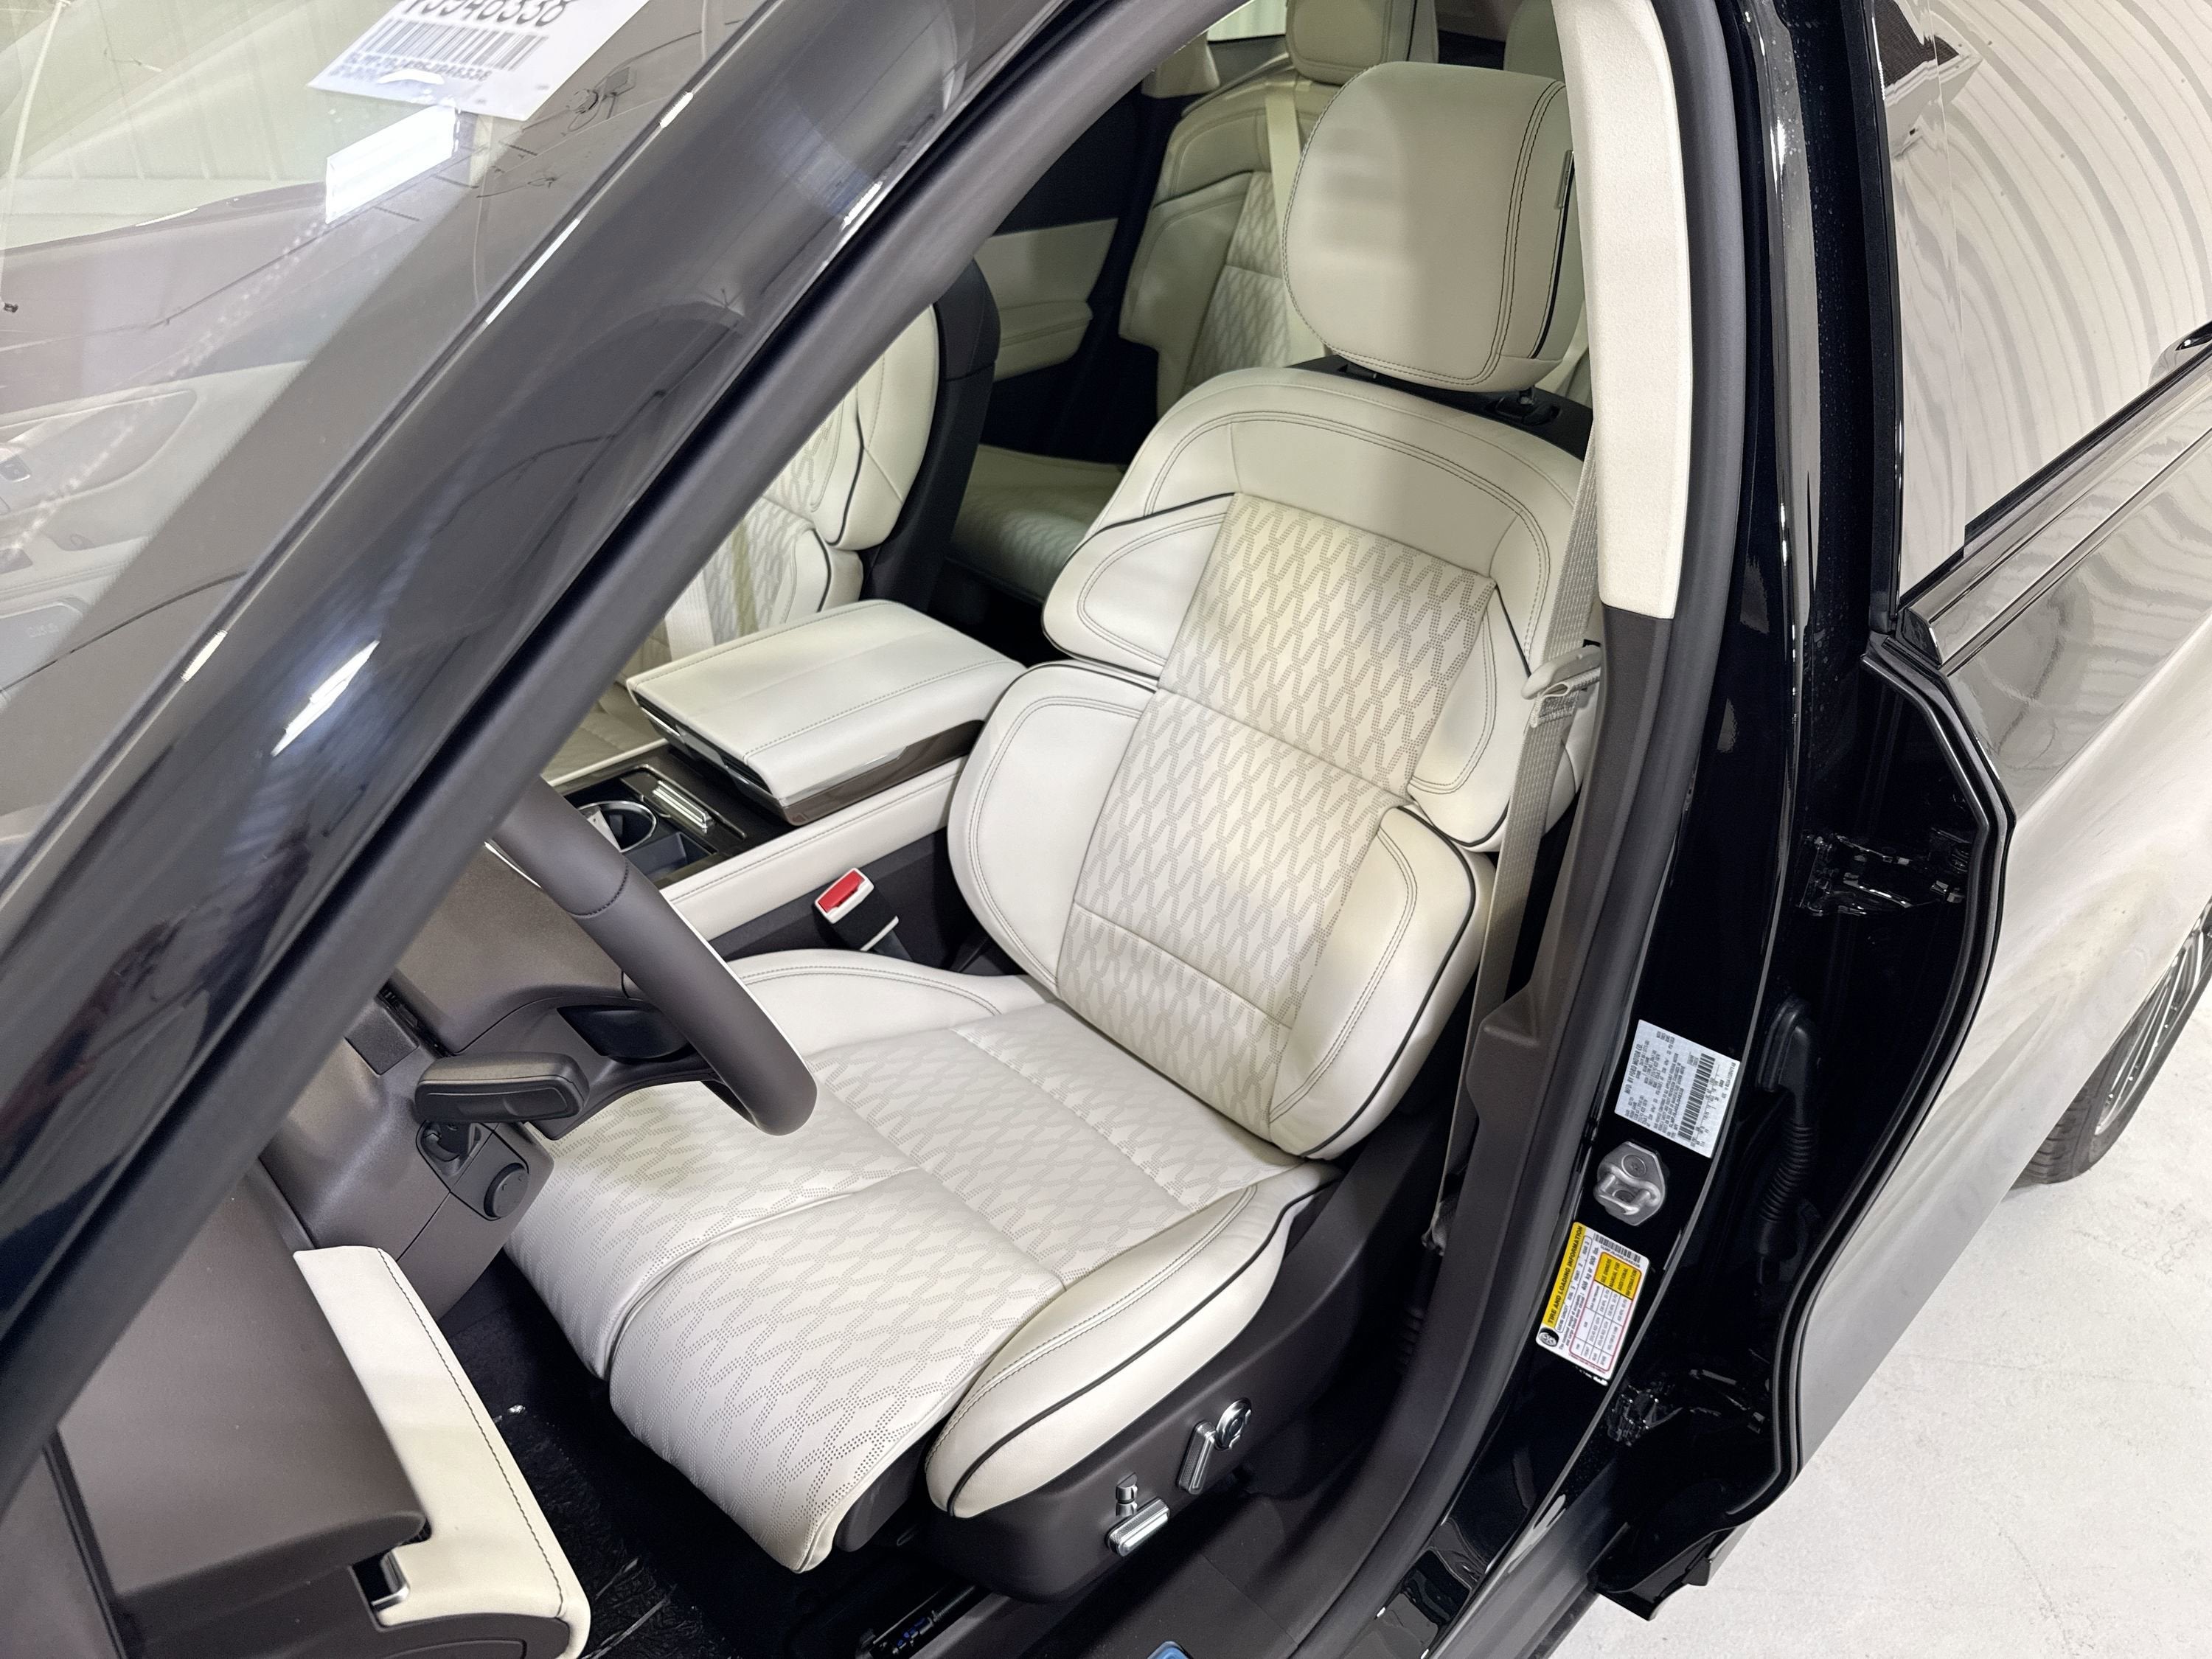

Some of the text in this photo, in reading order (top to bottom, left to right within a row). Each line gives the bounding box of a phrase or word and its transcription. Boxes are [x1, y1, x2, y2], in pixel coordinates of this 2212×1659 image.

[1632, 1049, 1641, 1065] MOTOR
[1628, 1064, 1637, 1077] FORD
[1624, 1082, 1632, 1094] MFD.
[1547, 1225, 1584, 1324] TIRE AND LOADING INFORMATION
